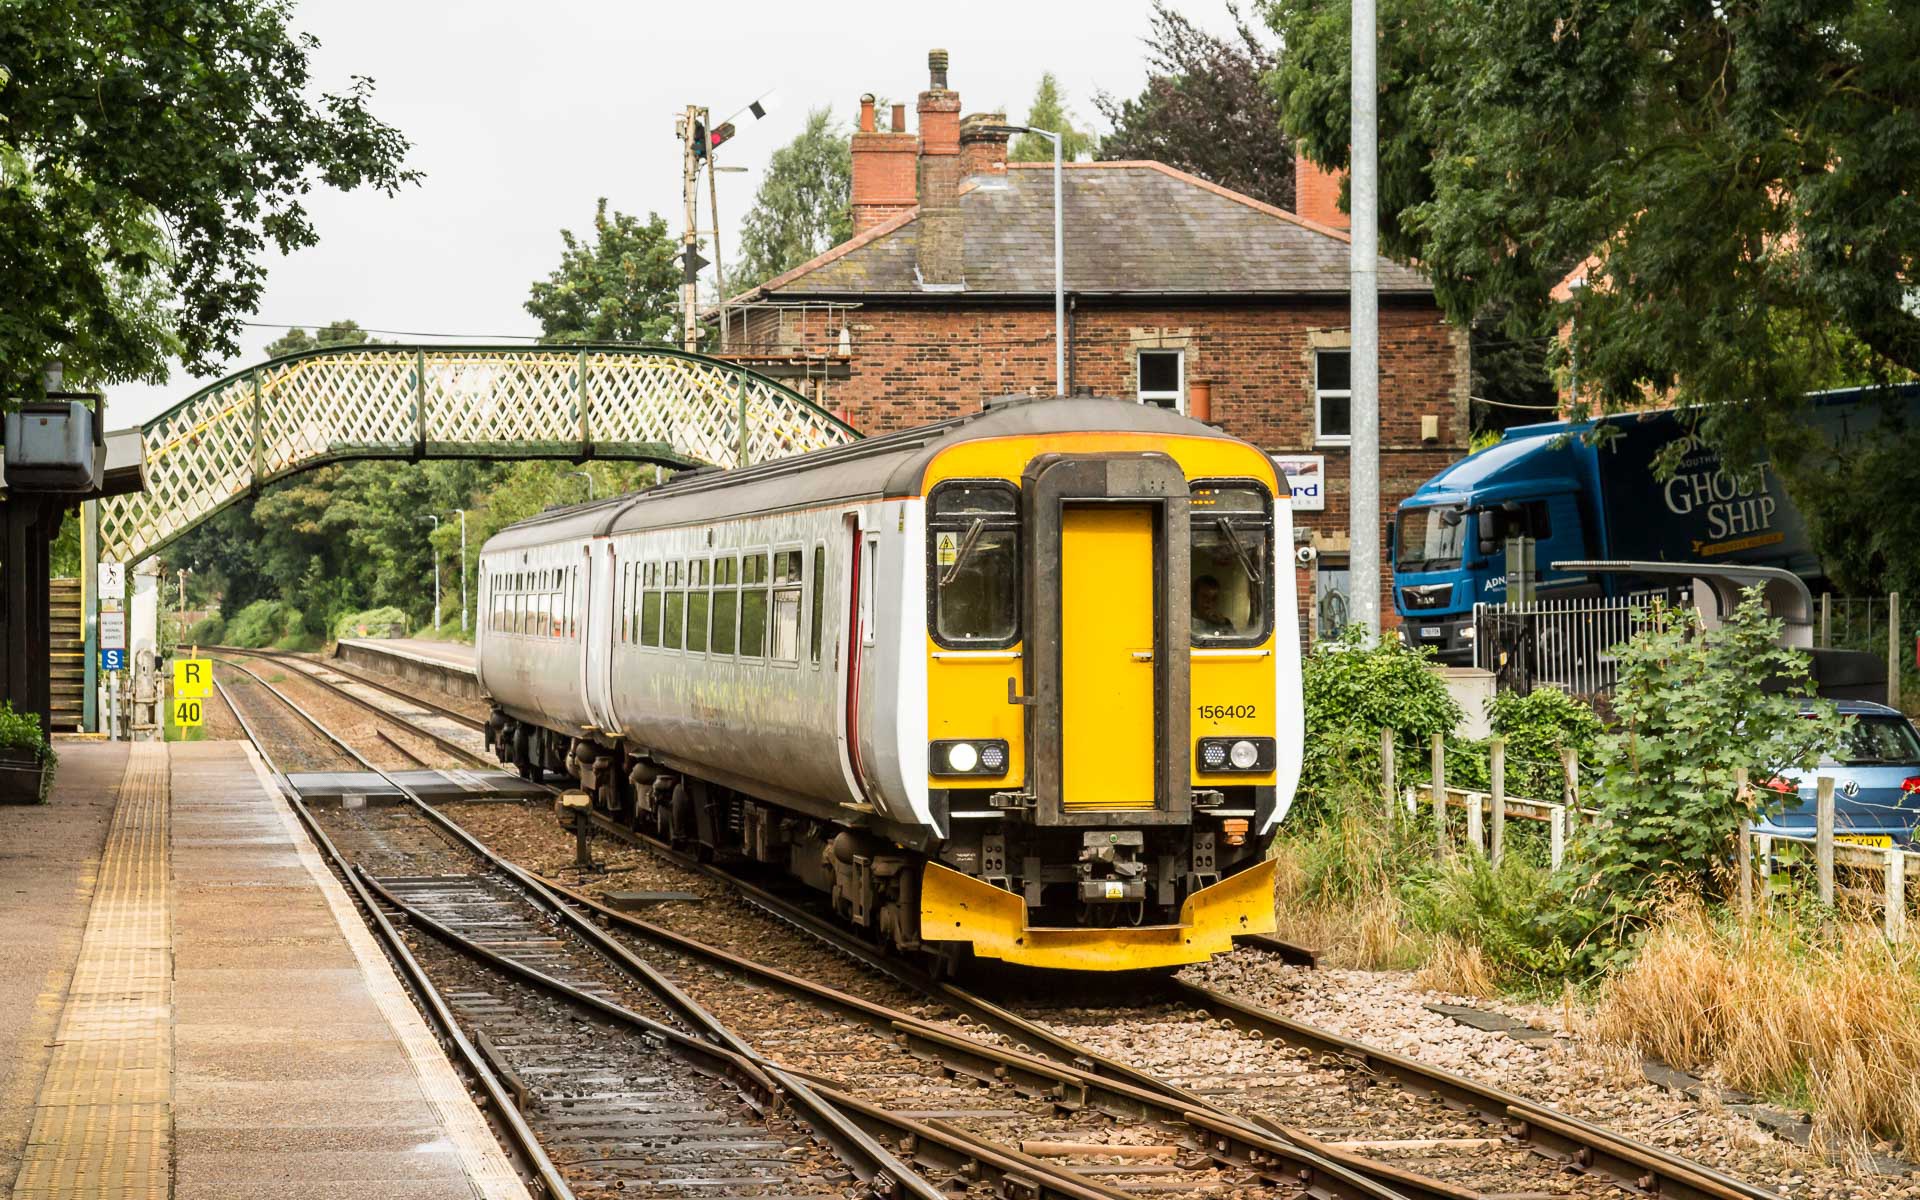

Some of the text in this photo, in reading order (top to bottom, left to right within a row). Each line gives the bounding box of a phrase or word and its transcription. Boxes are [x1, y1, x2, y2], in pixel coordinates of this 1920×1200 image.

[1291, 484, 1318, 497] rd
[1707, 496, 1776, 539] SHIP
[1484, 576, 1507, 592] ADN
[107, 650, 118, 665] S
[186, 663, 200, 683] R
[177, 703, 200, 722] 40
[1198, 705, 1256, 719] 156402
